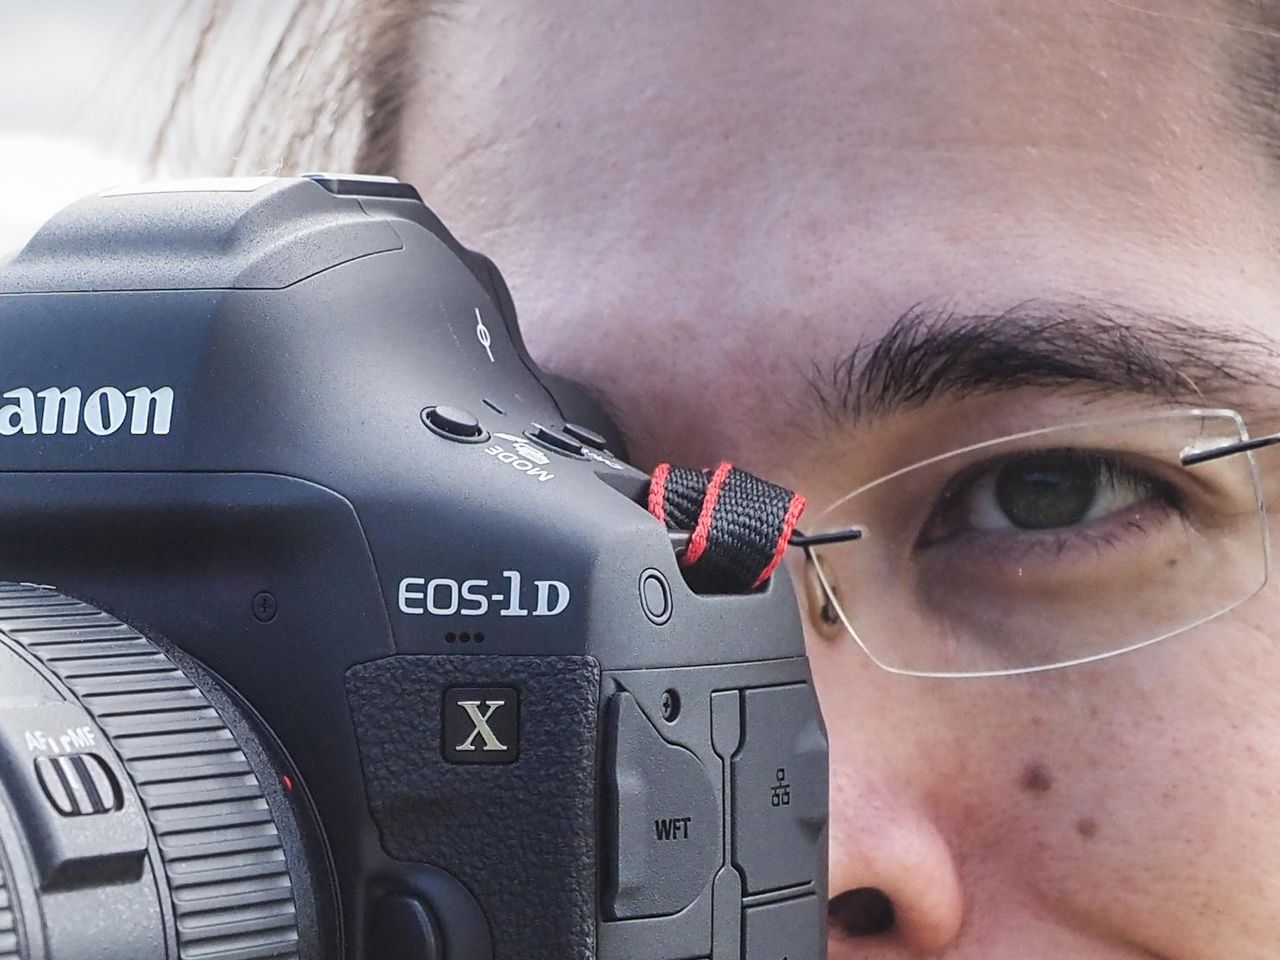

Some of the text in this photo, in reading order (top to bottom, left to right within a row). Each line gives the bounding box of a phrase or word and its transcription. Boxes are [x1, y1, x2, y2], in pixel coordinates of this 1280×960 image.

[484, 445, 554, 482] MODE
[24, 725, 96, 753] AF MF
[455, 700, 508, 751] X
[653, 817, 691, 841] WFT
